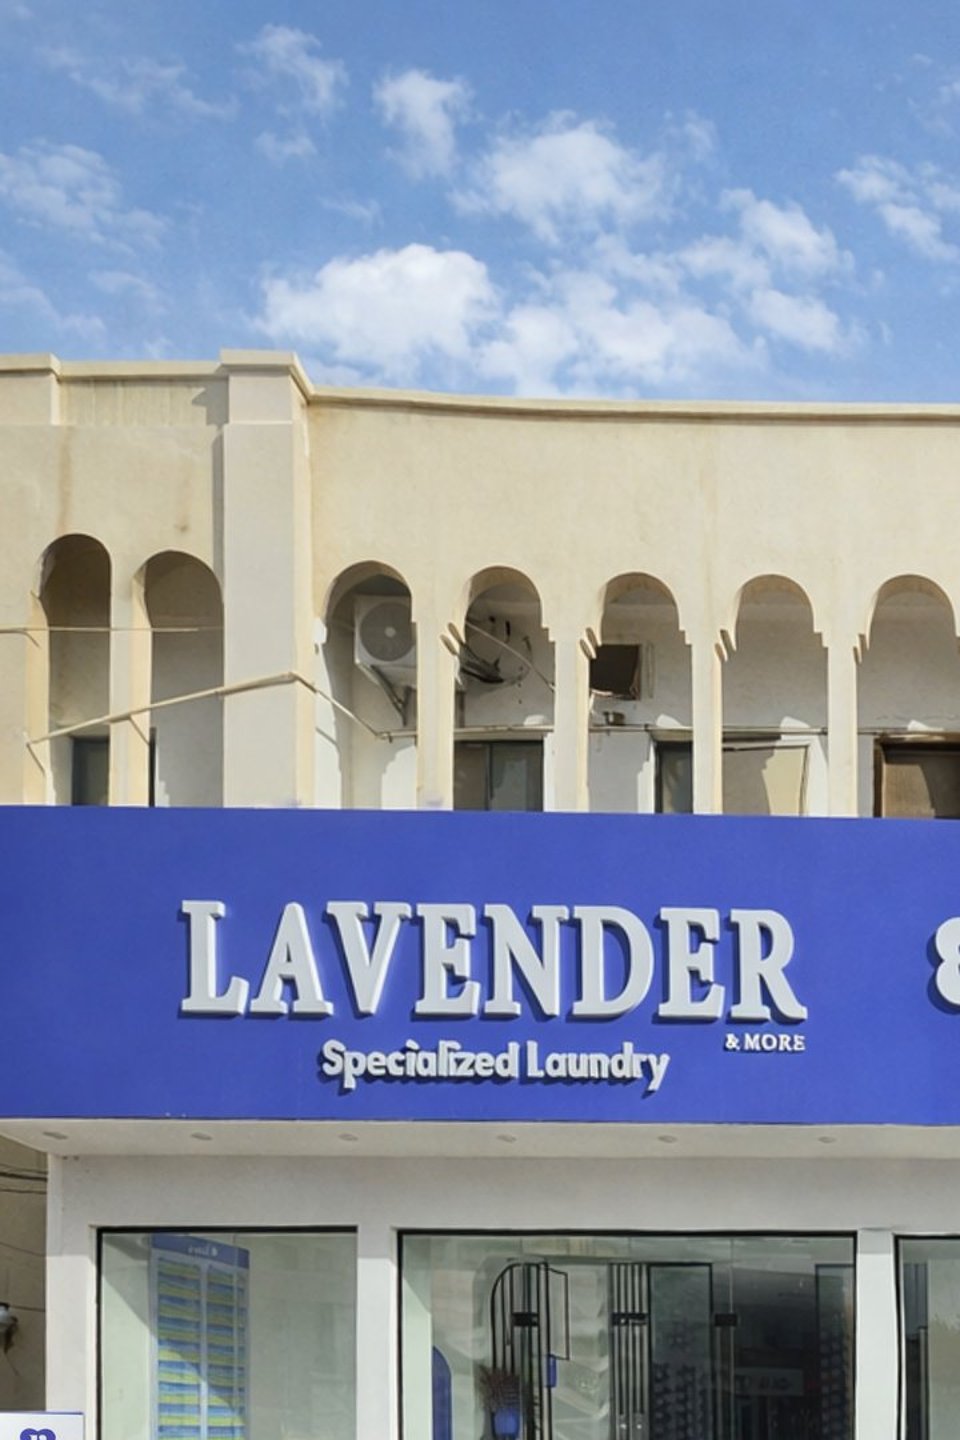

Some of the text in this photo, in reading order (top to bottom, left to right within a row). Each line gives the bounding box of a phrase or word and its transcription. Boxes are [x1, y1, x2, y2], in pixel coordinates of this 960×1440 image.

[181, 900, 808, 1021] LAVENDER
[321, 1038, 671, 1092] Specialized Laundry
[725, 1033, 806, 1052] & MORE
